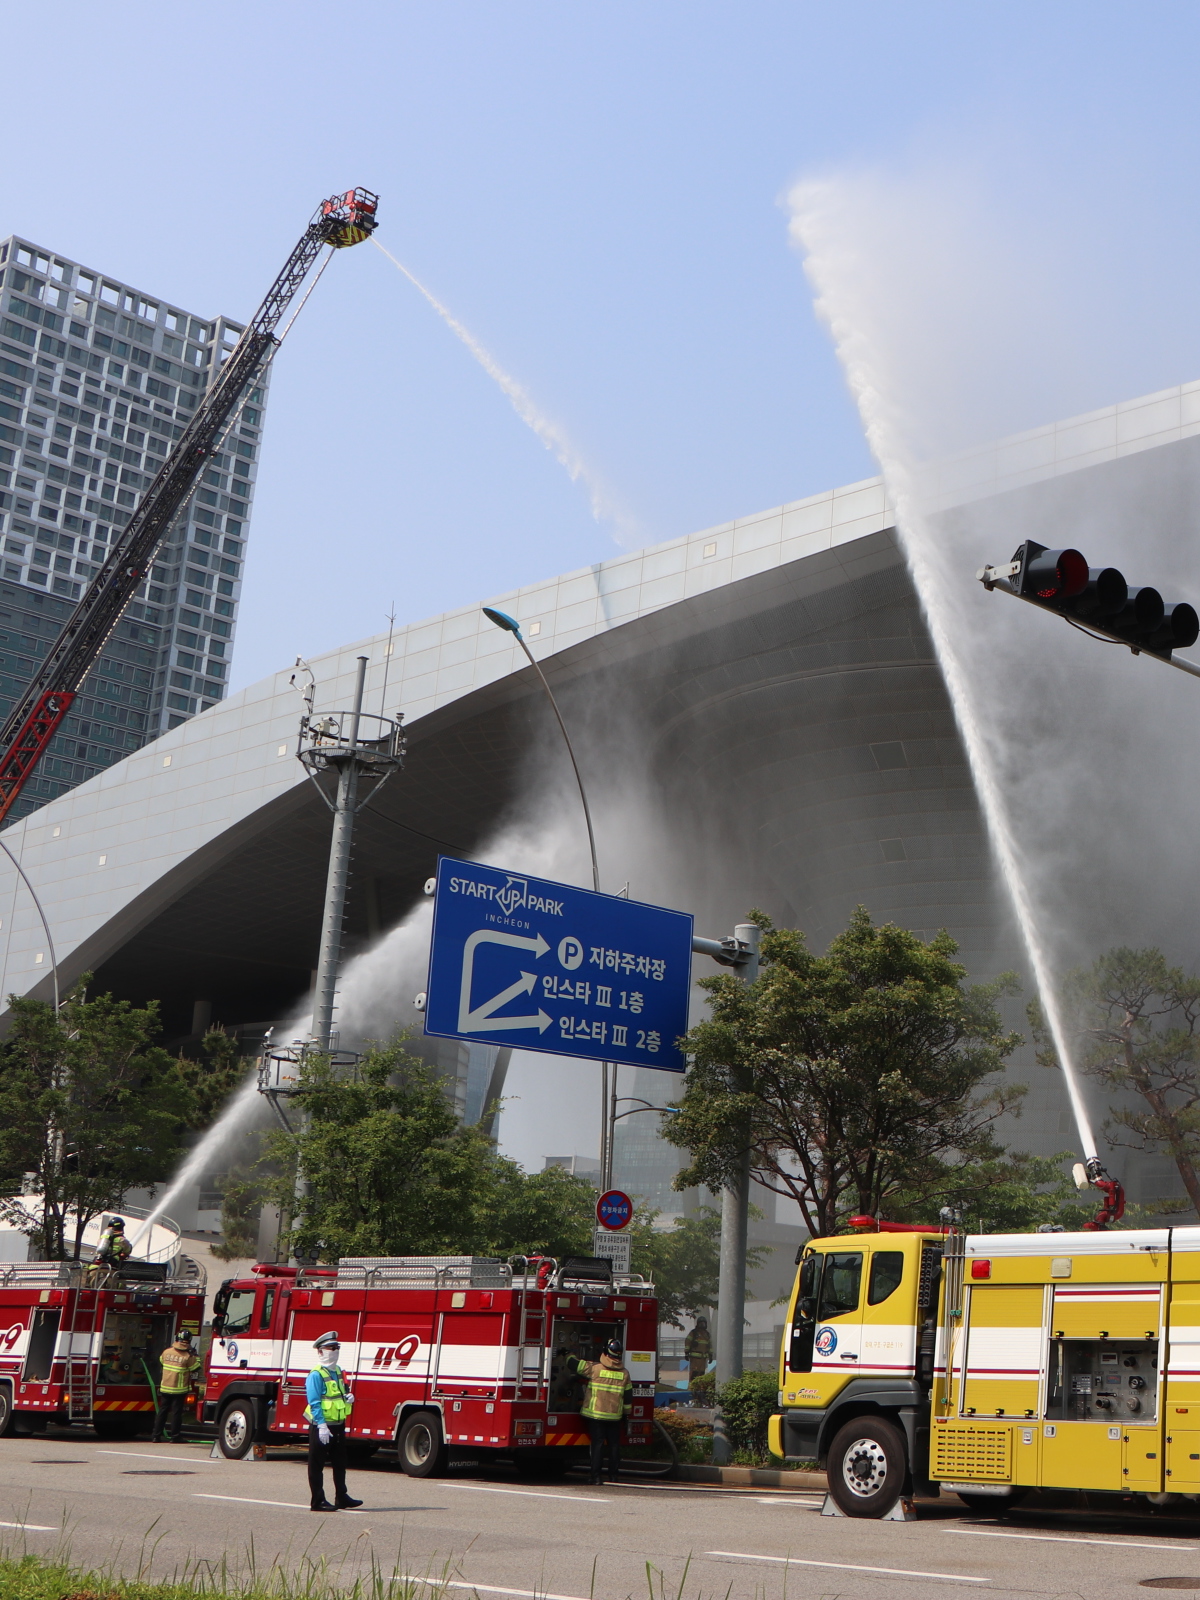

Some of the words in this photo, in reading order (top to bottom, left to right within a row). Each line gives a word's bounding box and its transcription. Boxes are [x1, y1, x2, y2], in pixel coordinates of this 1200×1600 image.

[449, 877, 497, 901] START
[527, 894, 564, 917] PARK
[485, 913, 531, 929] INCHEON
[589, 947, 666, 981] 지하주차장
[542, 975, 591, 1005] 인스타
[619, 991, 644, 1014] 1층
[559, 1016, 607, 1044] 인스타
[637, 1030, 661, 1053] 2층
[601, 1206, 628, 1214] 주정차금지
[371, 1336, 420, 1370] 119
